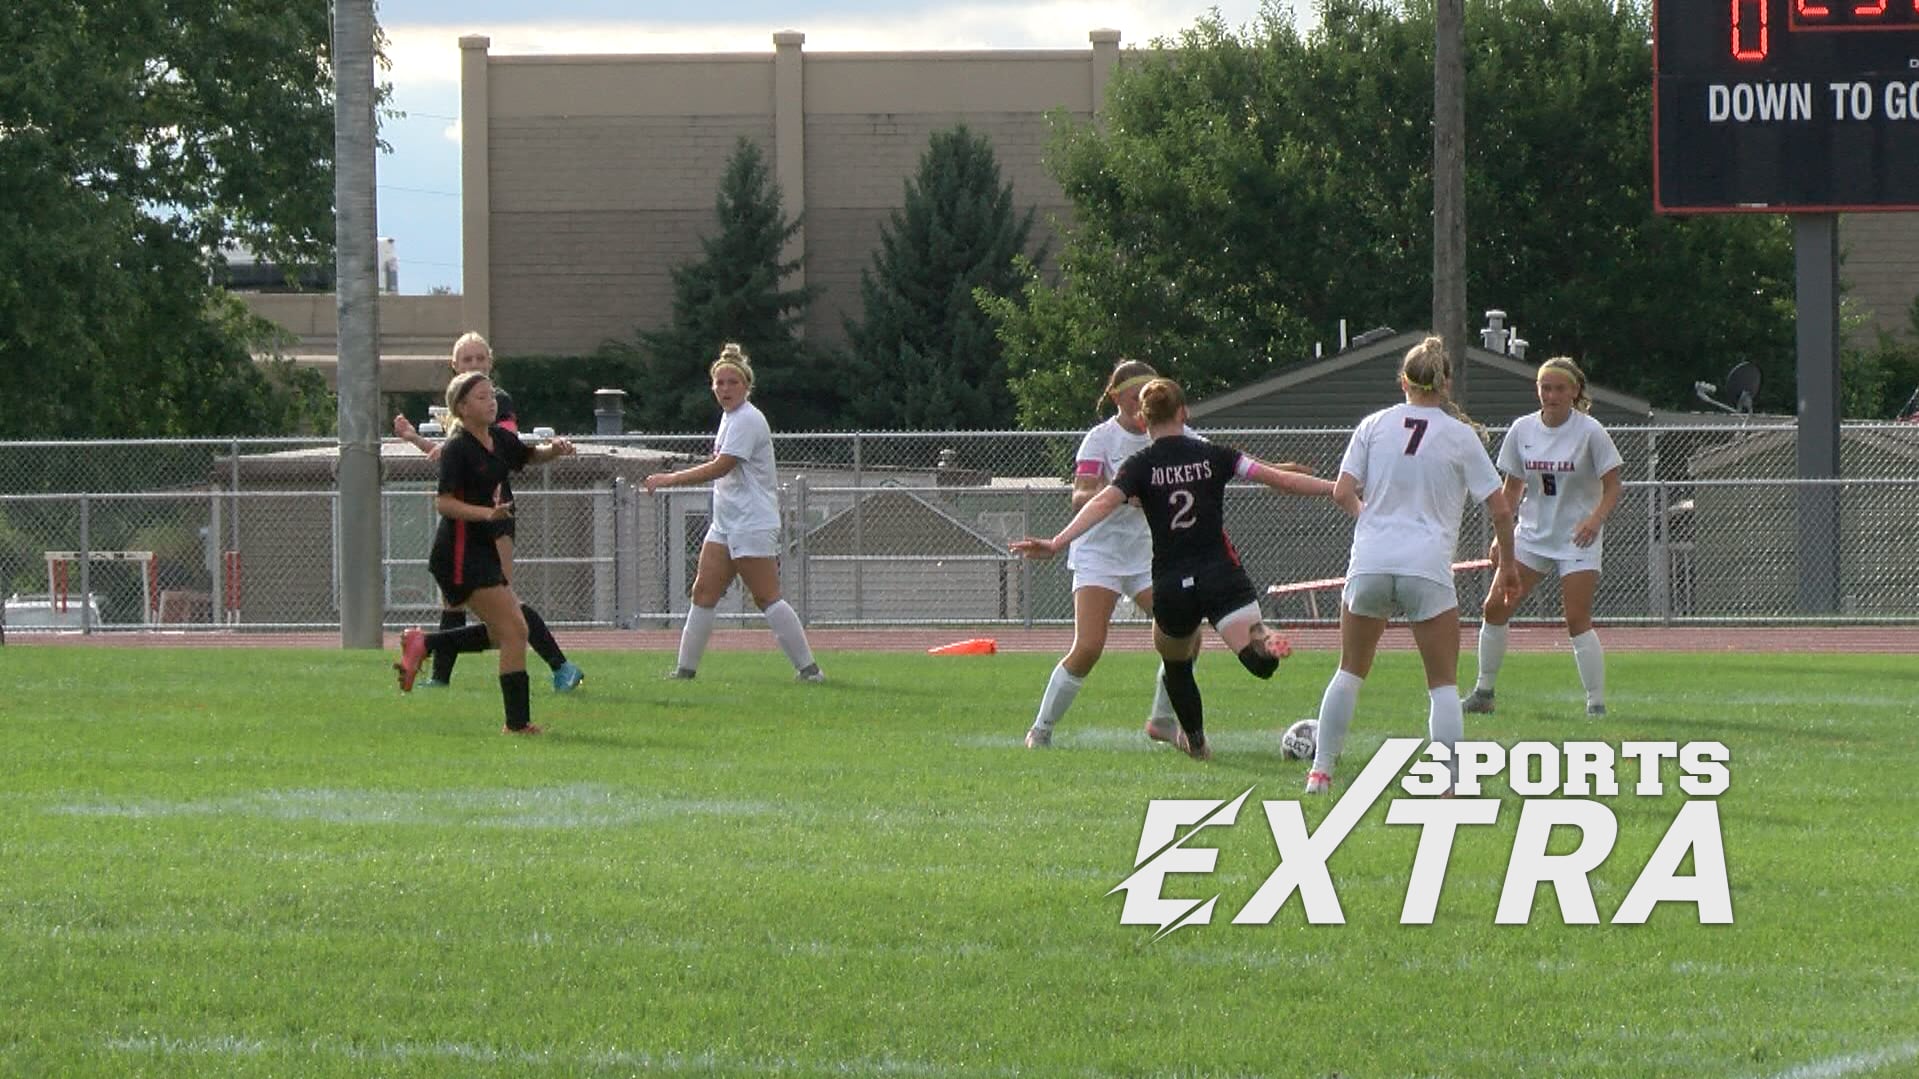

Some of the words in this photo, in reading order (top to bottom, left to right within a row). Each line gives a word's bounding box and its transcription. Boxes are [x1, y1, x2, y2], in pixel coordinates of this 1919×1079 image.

[1708, 82, 1811, 121] DOWN
[1830, 81, 1873, 120] TO
[1403, 417, 1429, 456] 7
[1169, 491, 1197, 530] 2
